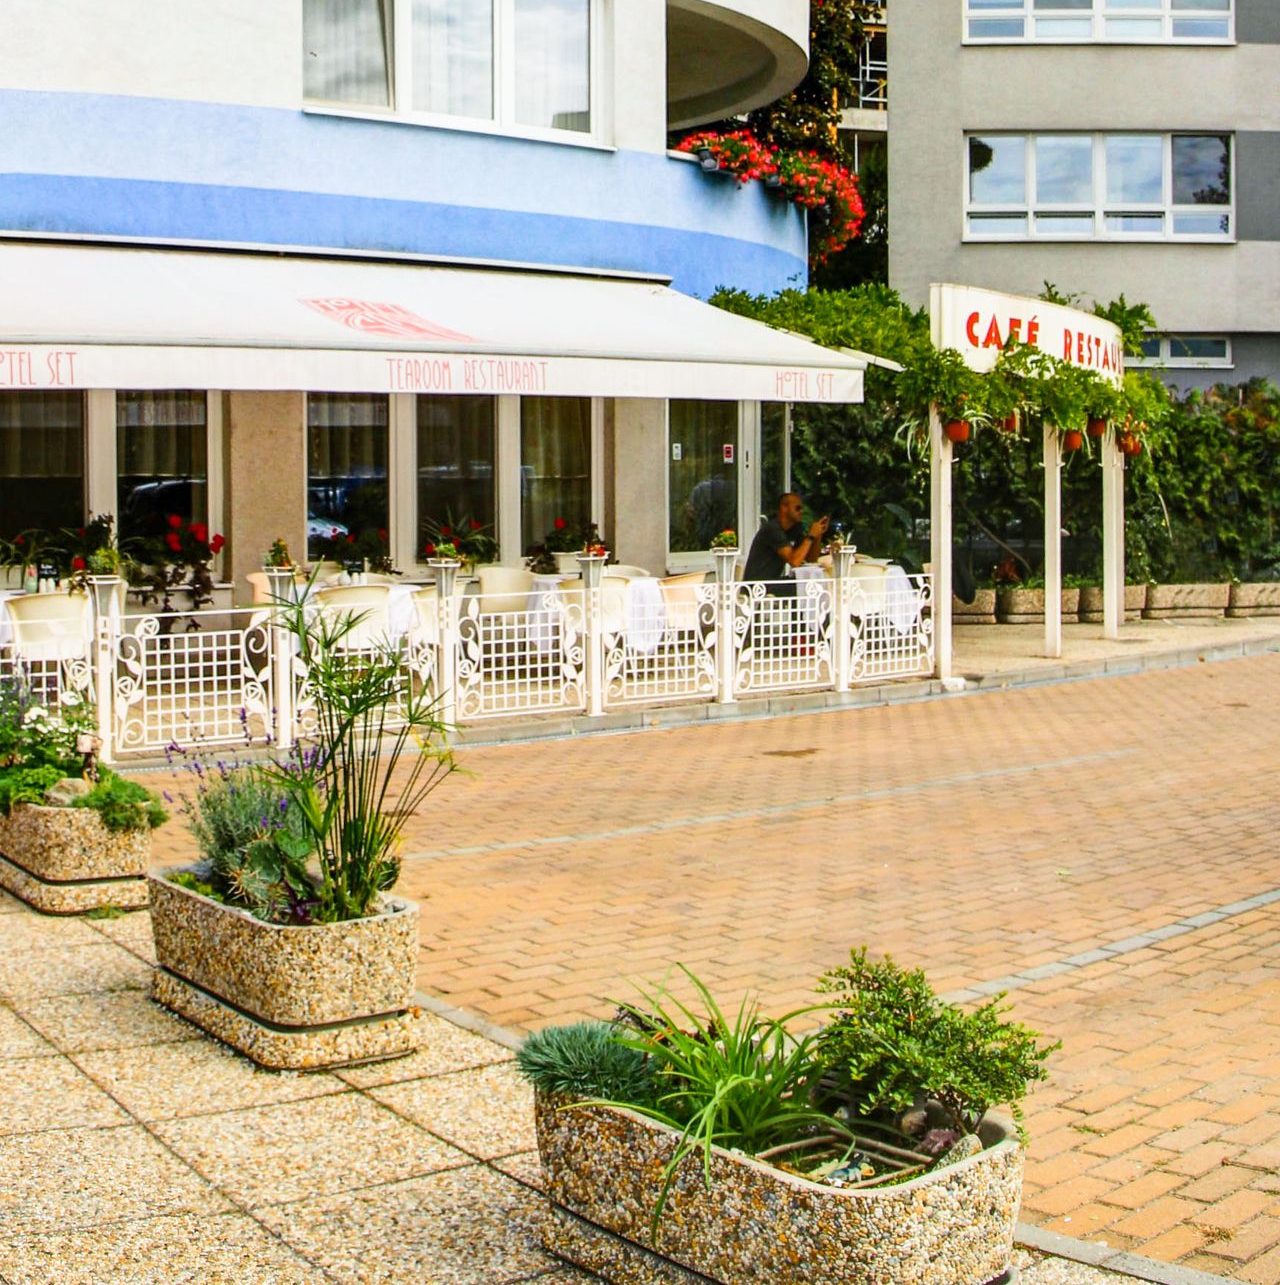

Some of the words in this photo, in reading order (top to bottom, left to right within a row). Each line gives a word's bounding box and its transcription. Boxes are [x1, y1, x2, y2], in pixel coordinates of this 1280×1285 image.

[966, 311, 1039, 352] CAFÉ
[47, 351, 77, 386] SET
[386, 358, 452, 390] TEAROOM
[464, 359, 548, 391] RESTAURANT
[776, 371, 810, 399] HOTEL
[816, 372, 835, 400] SET
